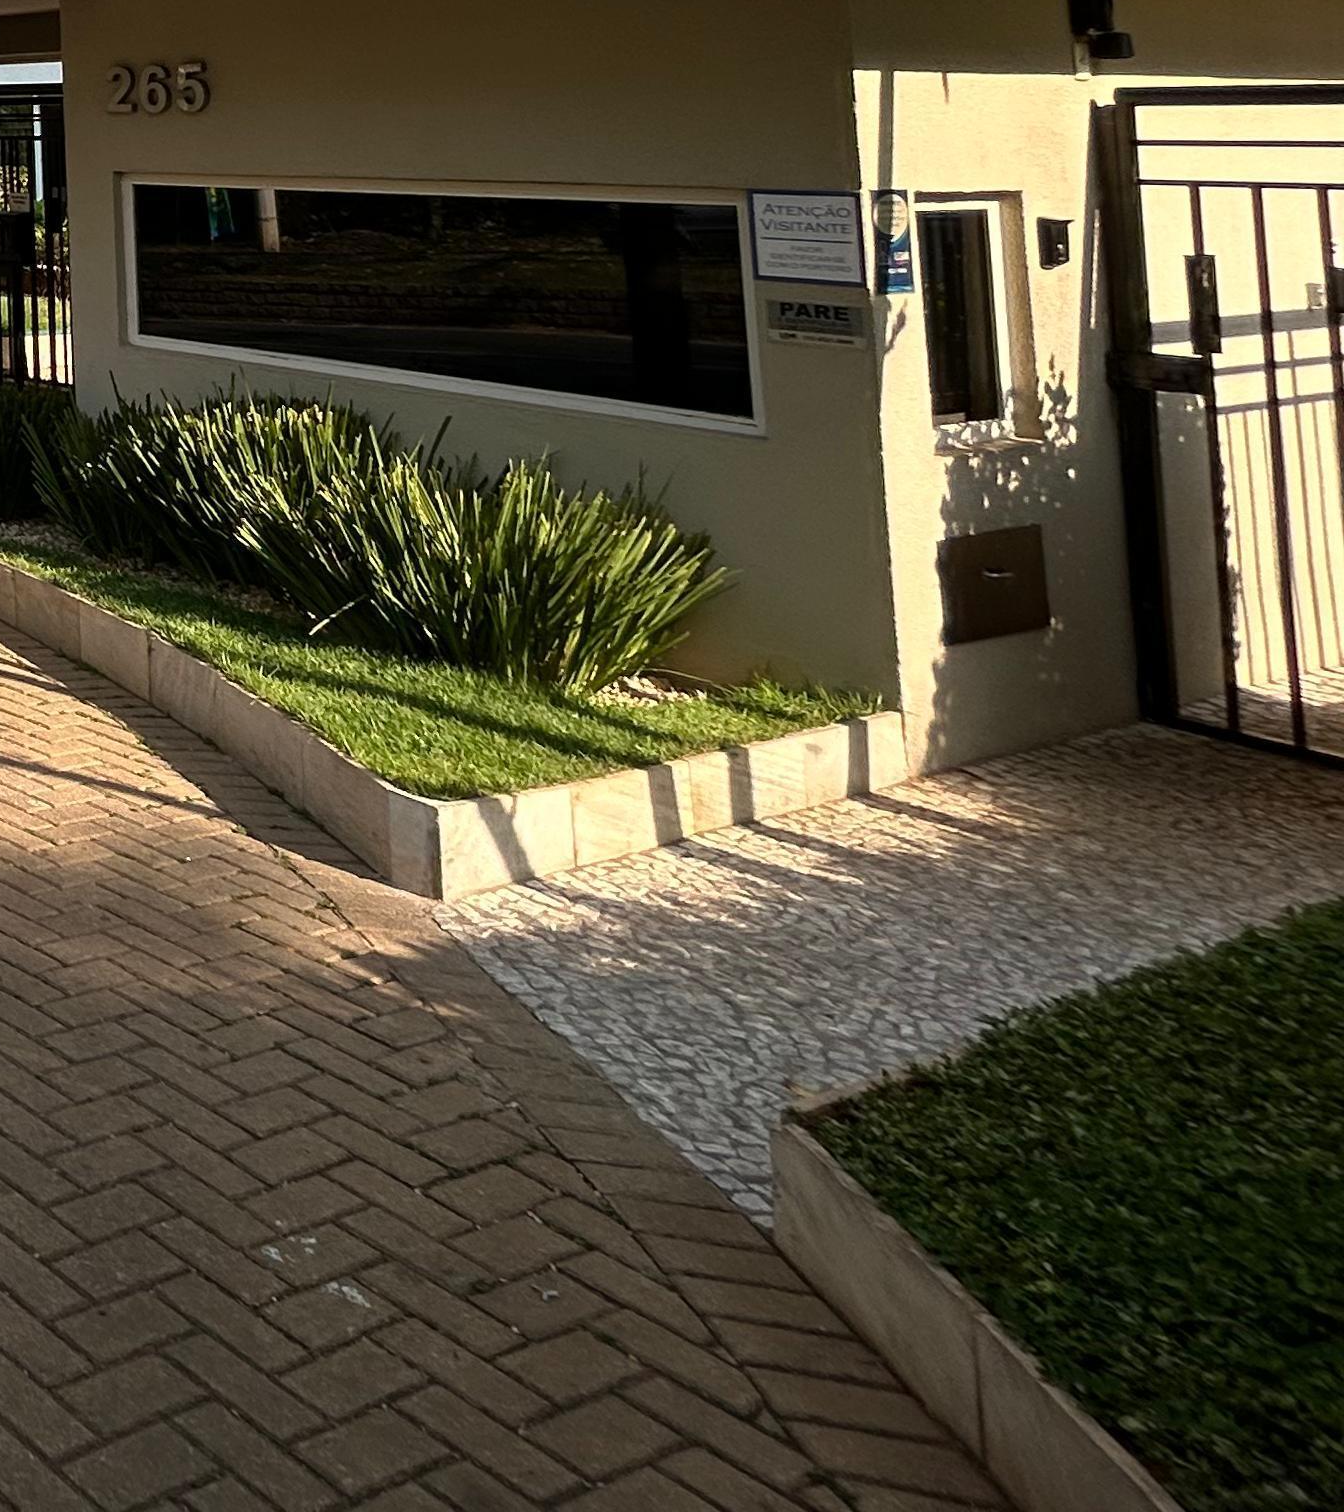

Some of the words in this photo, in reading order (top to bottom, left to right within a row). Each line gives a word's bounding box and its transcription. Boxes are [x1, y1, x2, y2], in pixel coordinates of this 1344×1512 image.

[105, 61, 211, 115] 265
[762, 203, 851, 219] ATENÇÃO
[759, 218, 853, 234] VISITANTE
[780, 303, 849, 321] PARE
